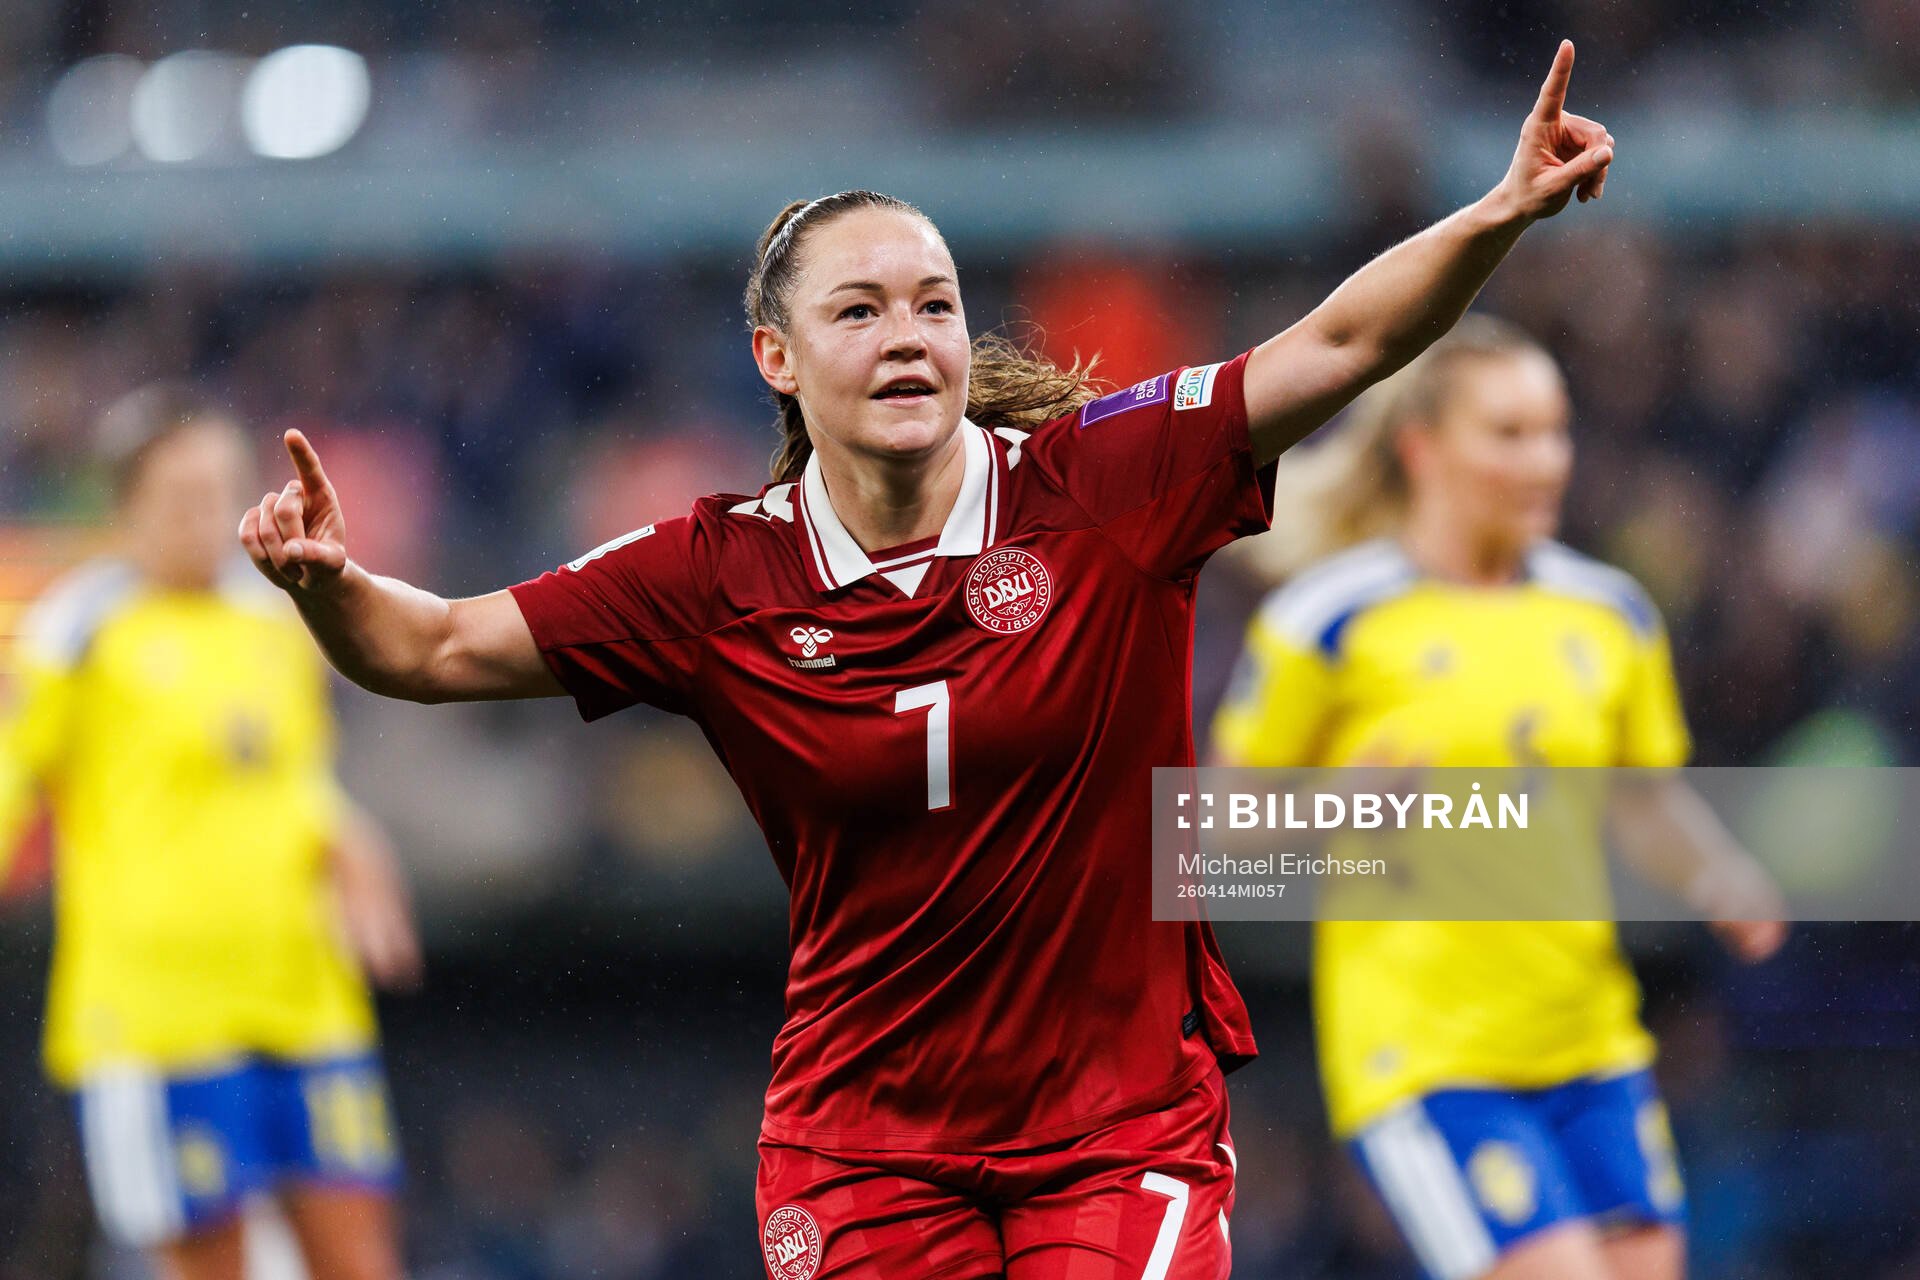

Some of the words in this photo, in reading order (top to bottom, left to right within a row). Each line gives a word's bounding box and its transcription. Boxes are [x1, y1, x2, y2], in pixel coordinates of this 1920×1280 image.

[1177, 384, 1186, 407] UEFA
[970, 586, 1000, 628] DANSK
[1007, 611, 1037, 630] 1889
[982, 571, 1034, 608] DBU
[787, 653, 836, 668] hummel
[894, 680, 950, 810] 7
[1140, 1171, 1189, 1280] 7
[774, 1229, 808, 1266] DBU
